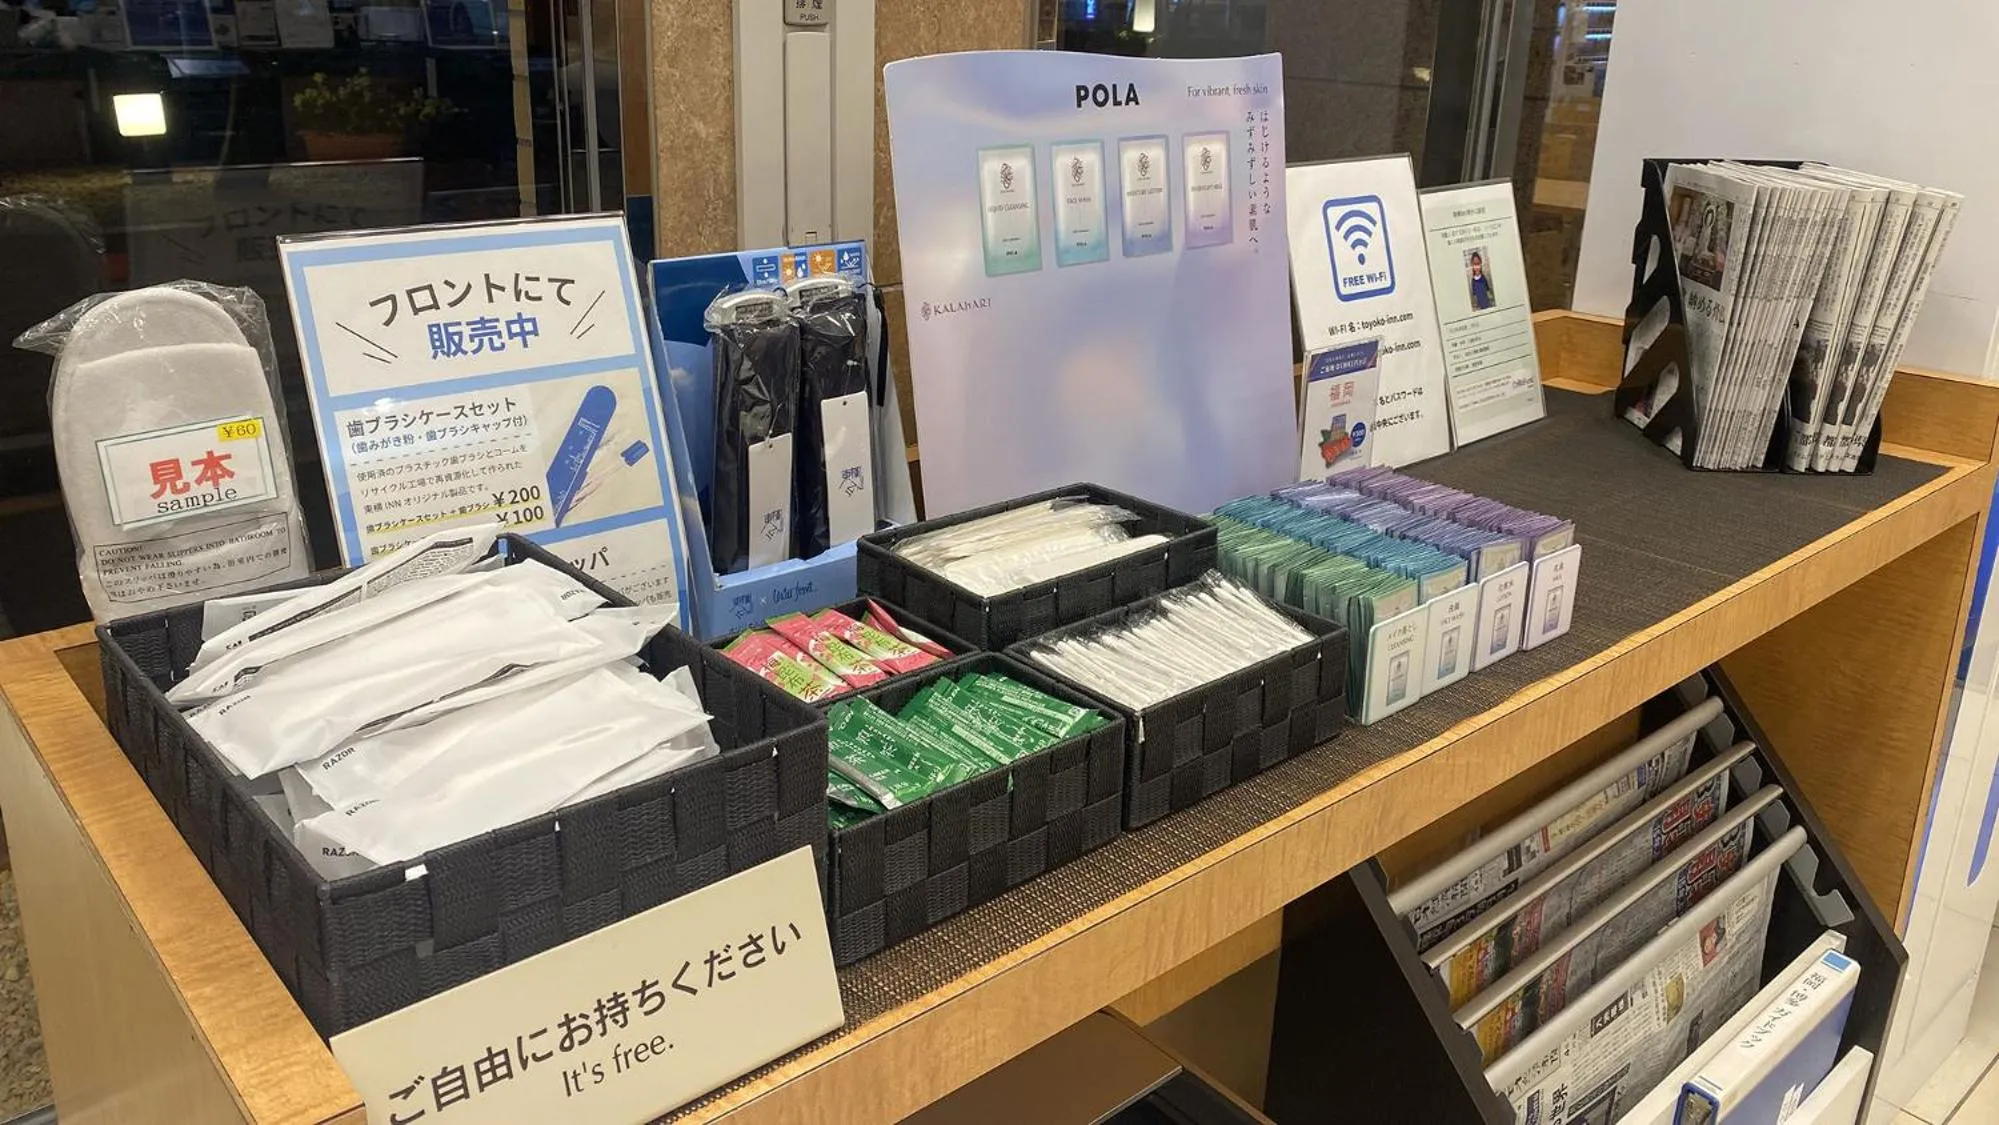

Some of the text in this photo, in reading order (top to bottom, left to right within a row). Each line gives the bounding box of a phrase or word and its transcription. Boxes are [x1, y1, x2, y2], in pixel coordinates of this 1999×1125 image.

[1076, 83, 1140, 108] POLA
[1260, 111, 1271, 215] はじけるような
[369, 273, 575, 327] フロントにて
[1342, 275, 1365, 288] FREE
[427, 312, 540, 360] 販売中
[223, 423, 257, 438] ¥60
[347, 397, 516, 438] 歯ブラシケースセット
[149, 450, 235, 500] 見本
[357, 445, 528, 482] 使用済のプラスチック歯ブラシとコームを
[360, 461, 523, 498] リサイクル工場で再資源化して作られた
[157, 486, 237, 513] sample
[321, 747, 357, 771] RAZOR
[388, 920, 803, 1125] ご自由にお持ちください
[1739, 1006, 1793, 1050] ガイドブック
[562, 1031, 675, 1098] It's free.
